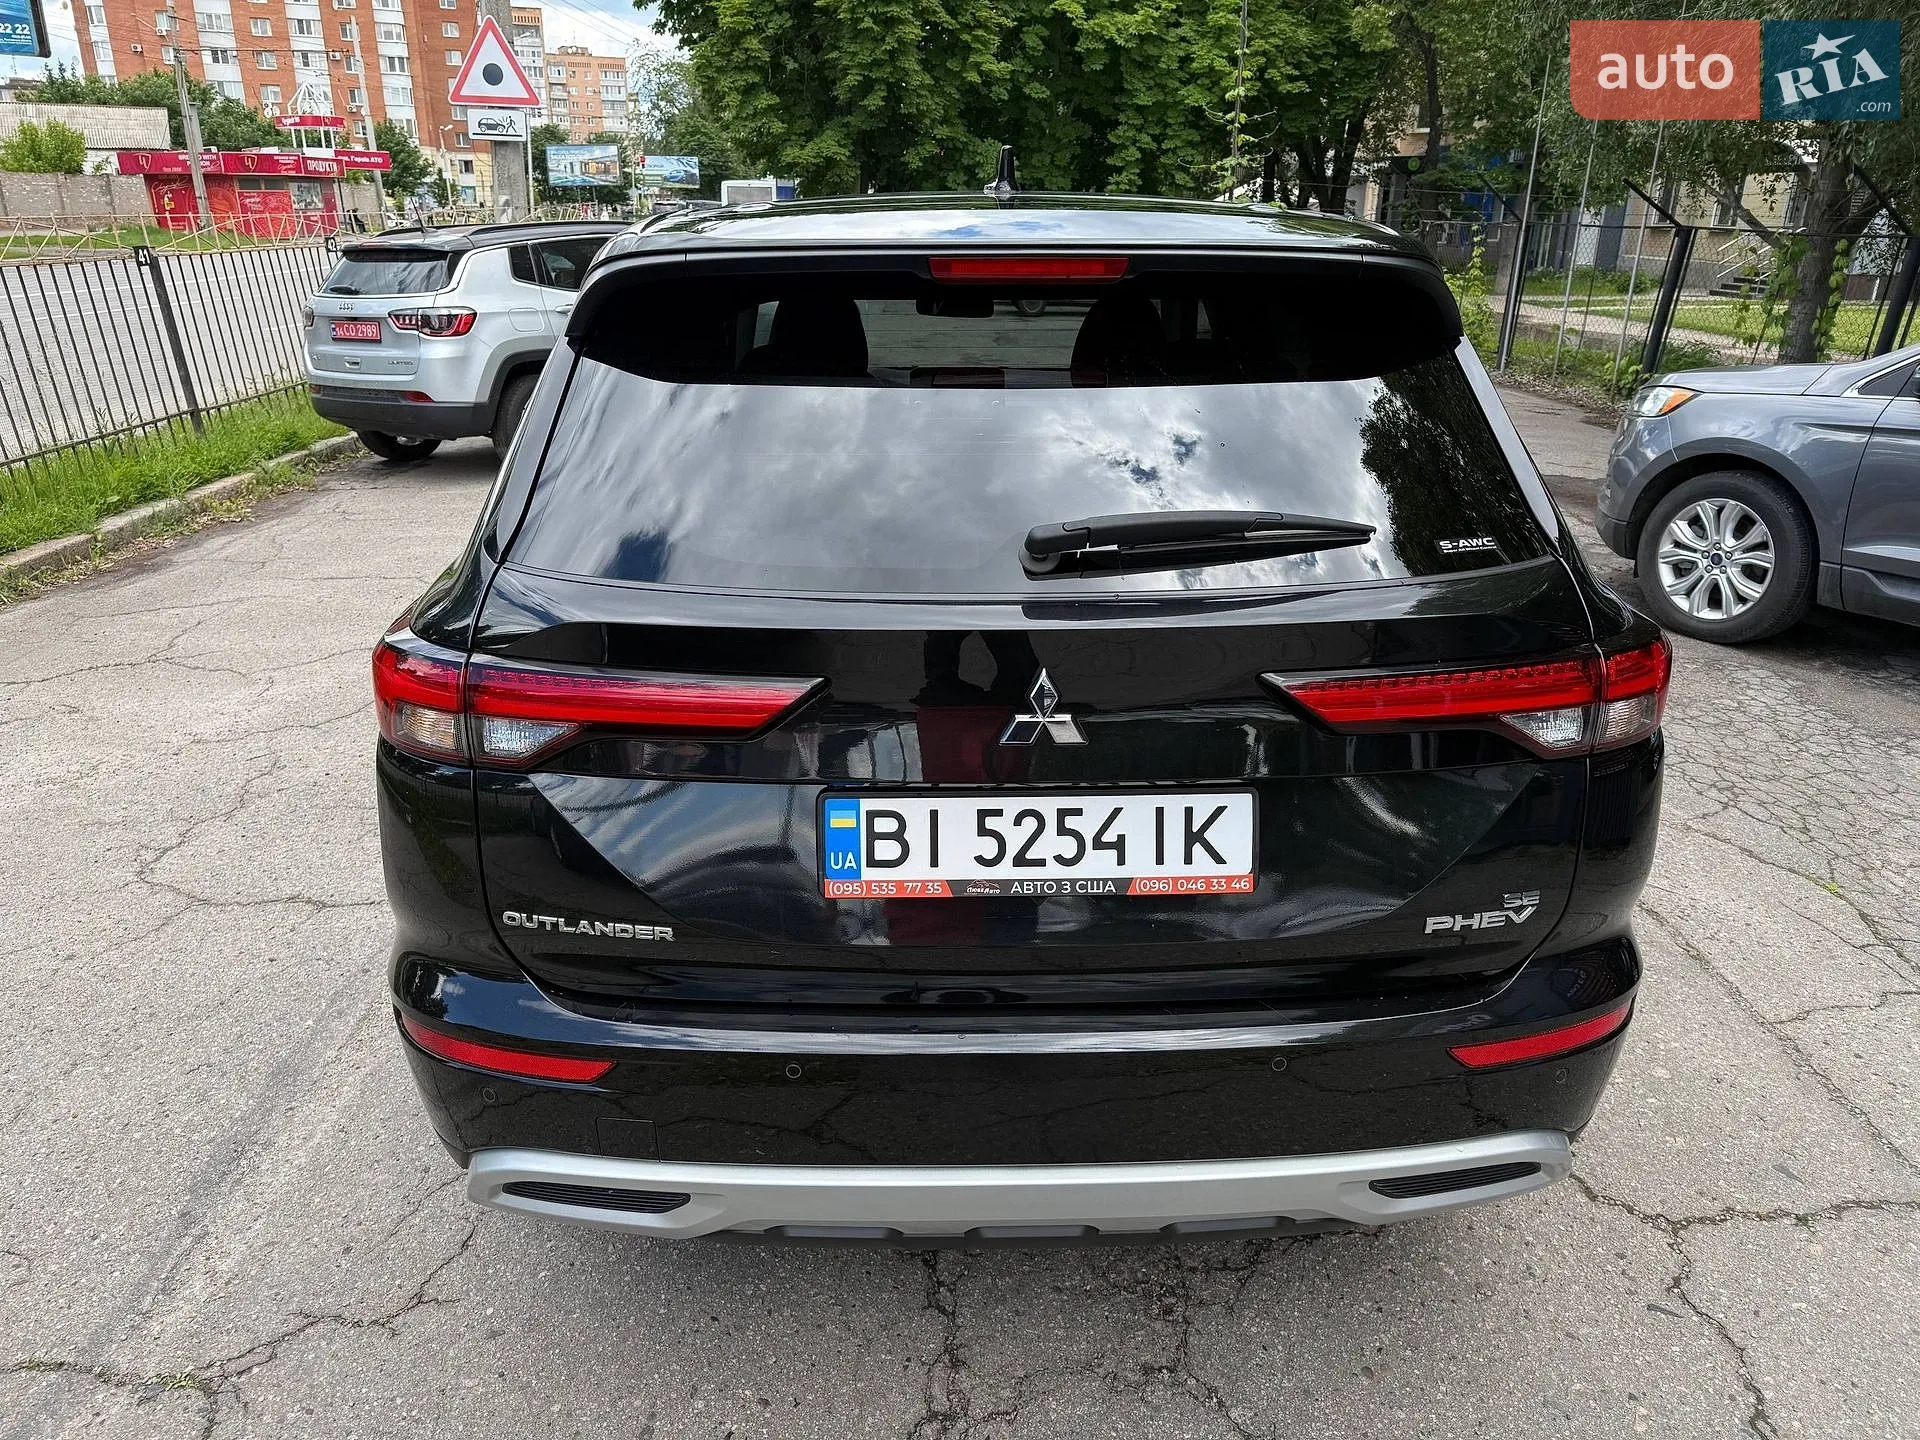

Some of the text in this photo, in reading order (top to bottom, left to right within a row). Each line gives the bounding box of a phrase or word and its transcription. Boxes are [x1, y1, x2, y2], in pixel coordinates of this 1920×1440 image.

[14, 24, 31, 34] 22
[307, 160, 338, 172] ПРОДУКТИ
[138, 248, 150, 264] 41
[357, 325, 377, 337] 2989
[1439, 537, 1495, 549] S-AWC
[865, 805, 1229, 868] BI 5254 IK
[830, 851, 857, 871] UA
[829, 881, 942, 897] (095) 535 77 35
[1010, 881, 1057, 894] АВТО
[1075, 880, 1117, 893] США
[1135, 877, 1250, 893] (096) 046 33 46
[1502, 890, 1541, 908] SE
[502, 911, 677, 942] OUTLANDER
[1424, 906, 1538, 934] PHEV
